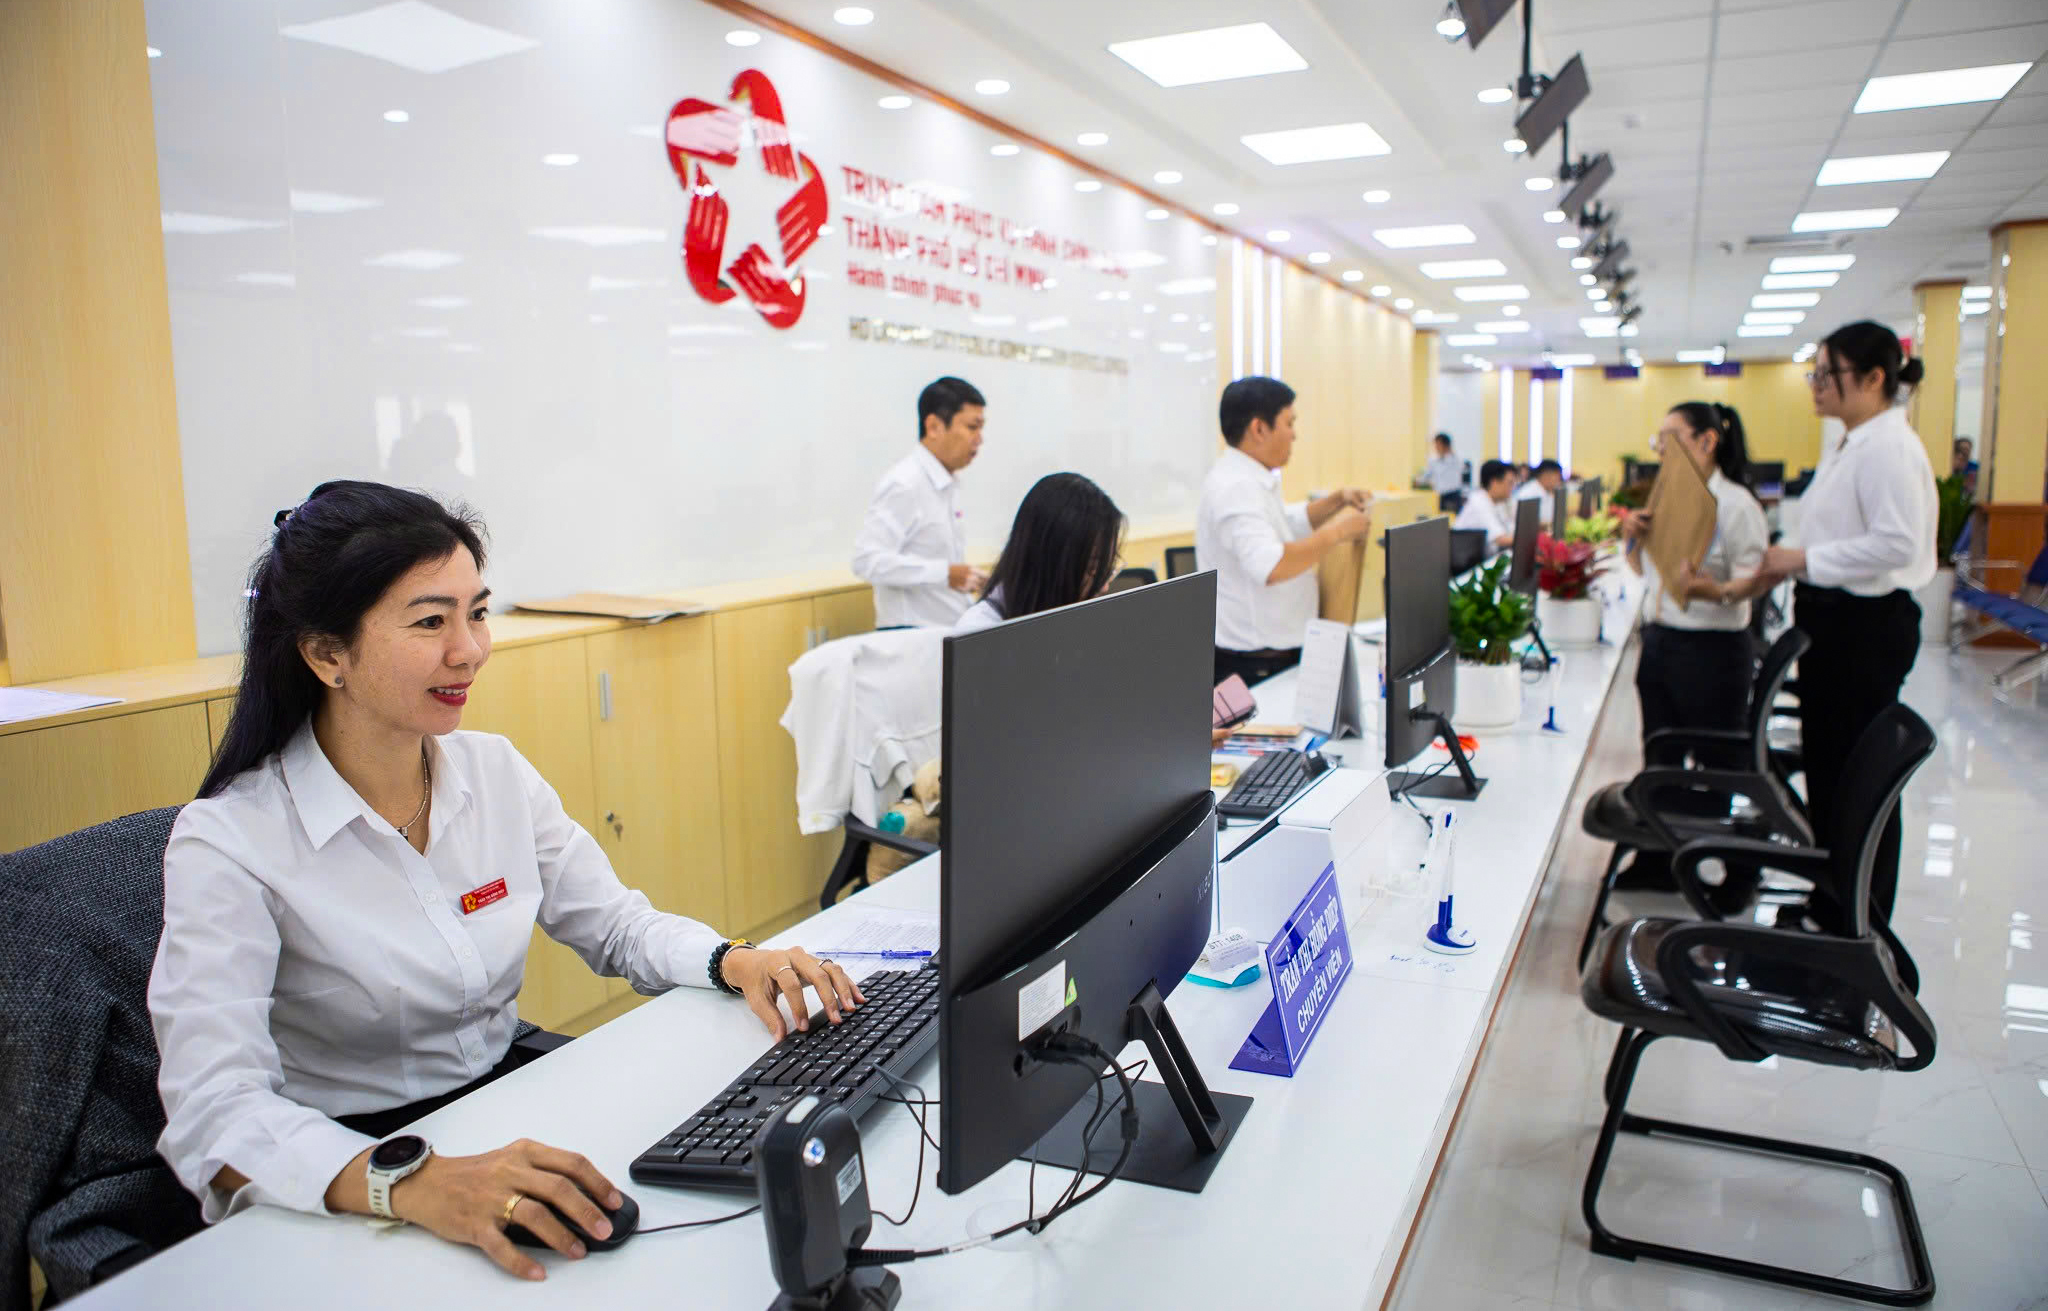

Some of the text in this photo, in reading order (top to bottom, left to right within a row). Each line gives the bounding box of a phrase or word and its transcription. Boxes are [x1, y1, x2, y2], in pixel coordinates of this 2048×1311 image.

[1280, 945, 1301, 1004] TRẦN
[1297, 937, 1314, 980] THỊ
[1308, 910, 1327, 960] HỒNG
[1297, 946, 1343, 1034] CHUYÊN VIÊN
